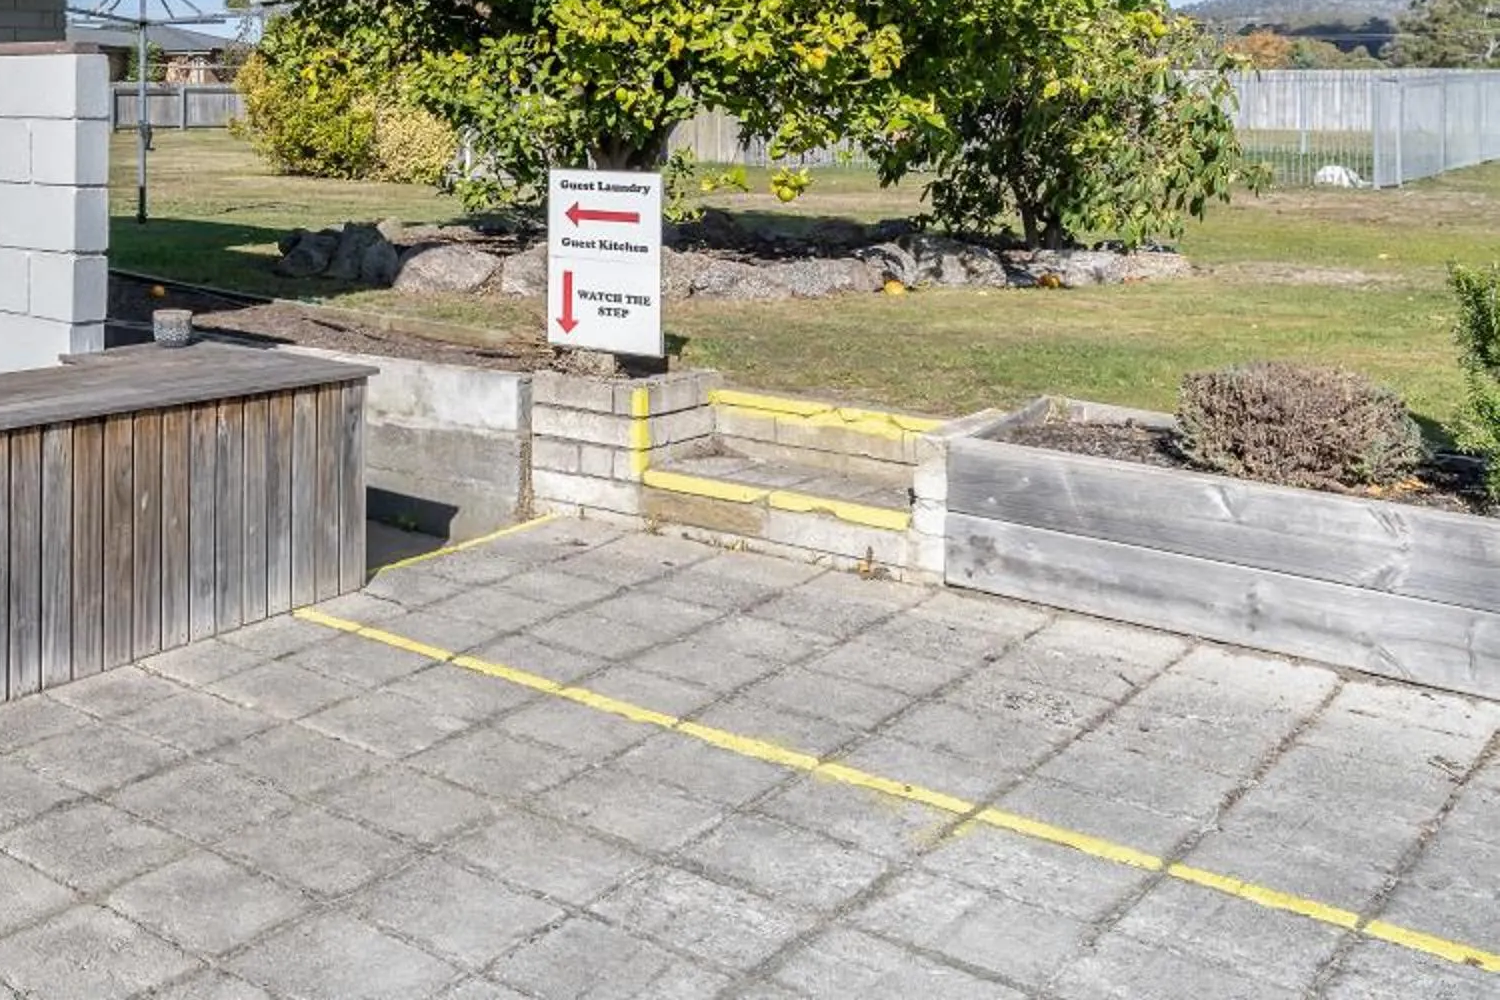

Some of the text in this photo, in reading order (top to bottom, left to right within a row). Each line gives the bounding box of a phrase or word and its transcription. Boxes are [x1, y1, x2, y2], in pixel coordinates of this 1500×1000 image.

[560, 180, 651, 195] Guest Laundry
[561, 237, 649, 253] Guest Kitchen
[577, 289, 652, 307] WATCH THE
[597, 306, 630, 318] STEP
